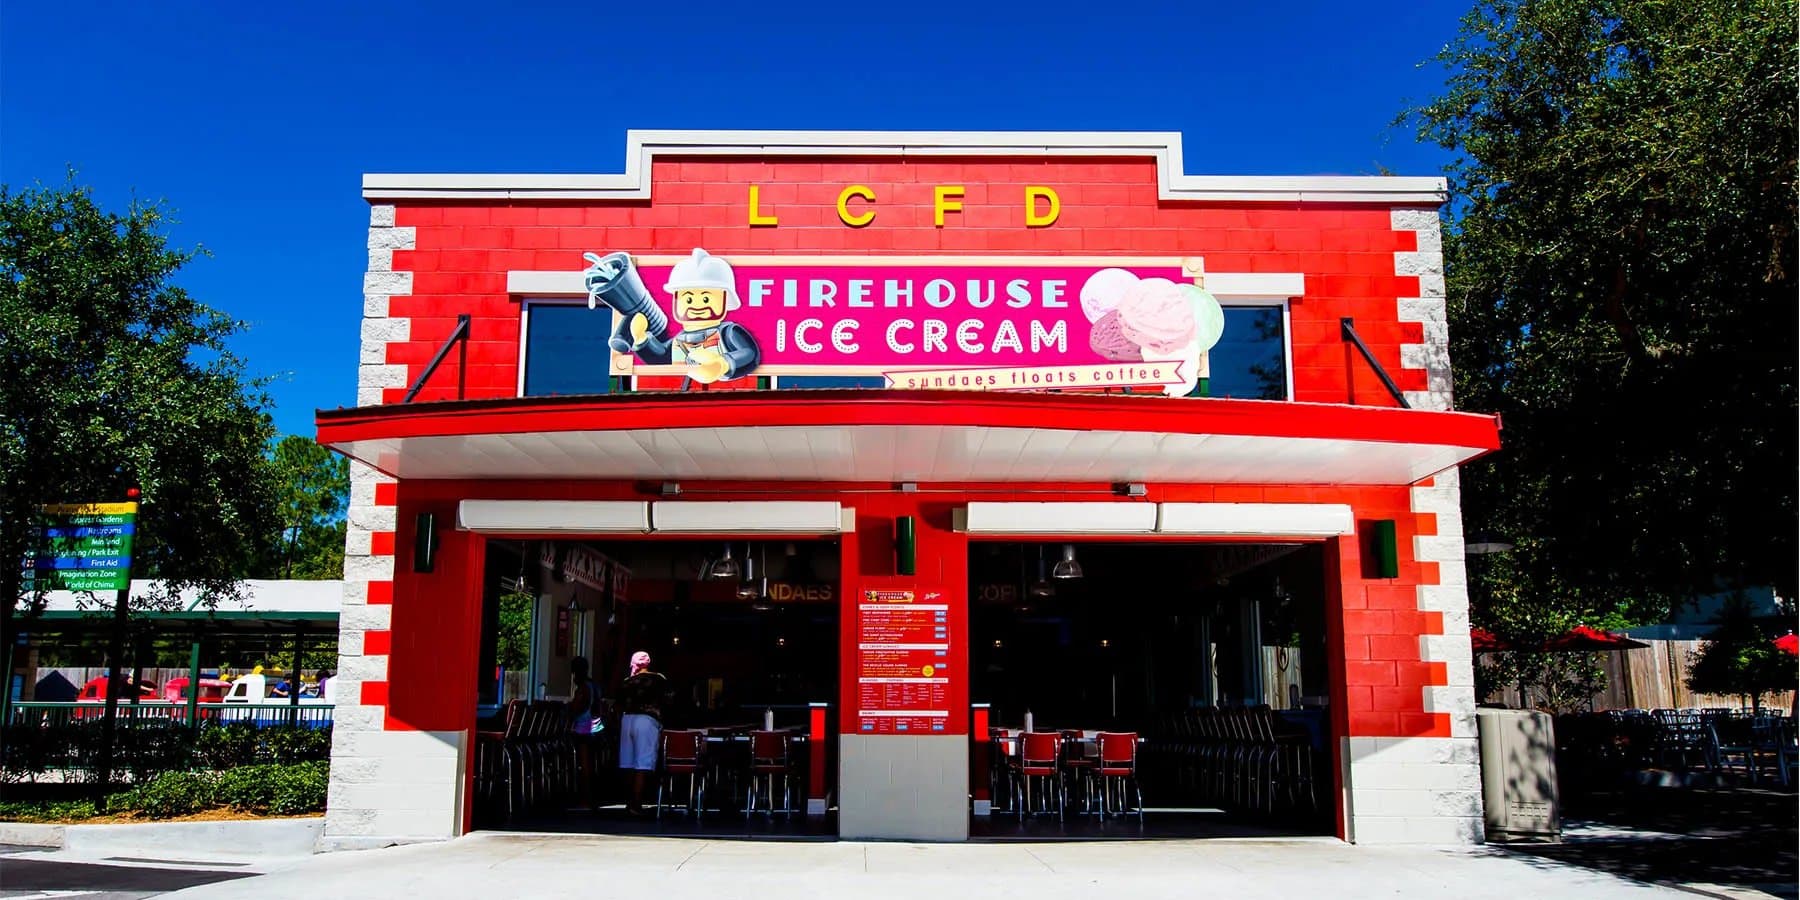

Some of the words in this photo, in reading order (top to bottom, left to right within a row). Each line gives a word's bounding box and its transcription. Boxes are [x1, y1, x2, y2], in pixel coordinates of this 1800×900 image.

[748, 279, 1068, 308] FIREHOUSE
[776, 318, 860, 353] ICE
[886, 318, 1067, 353] CREAM
[908, 373, 996, 389] sundaes
[1011, 370, 1077, 385] floats
[1093, 367, 1162, 381] coffee
[91, 559, 106, 567] First
[59, 570, 99, 578] Imagination
[100, 570, 117, 578] Zone
[85, 580, 92, 588] of
[93, 580, 115, 588] Chima
